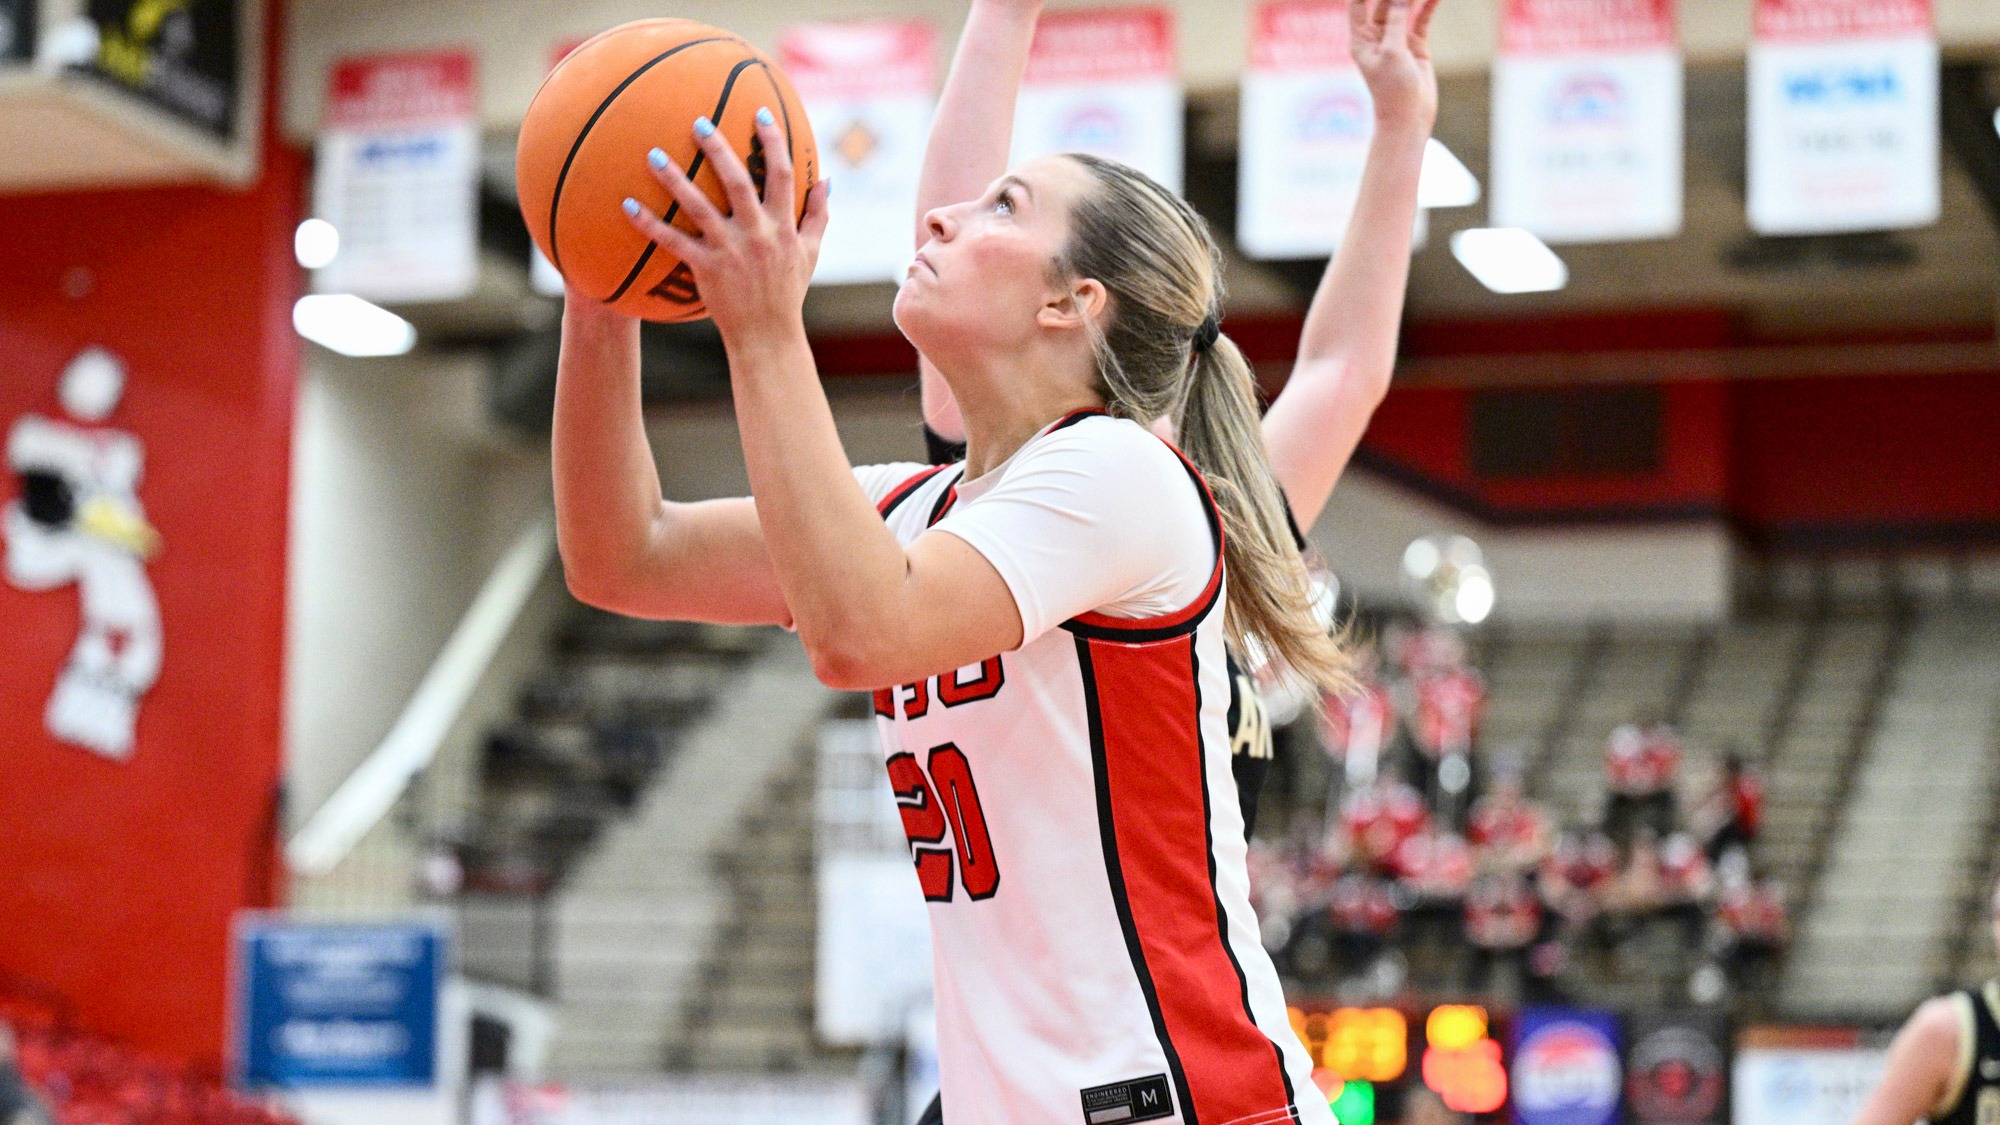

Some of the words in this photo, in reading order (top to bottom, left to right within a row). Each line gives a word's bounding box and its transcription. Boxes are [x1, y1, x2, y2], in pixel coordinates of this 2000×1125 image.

[1229, 674, 1274, 760] AN
[886, 741, 1001, 903] 20
[1085, 1087, 1127, 1100] ENGINEERED
[1141, 1088, 1158, 1107] M
